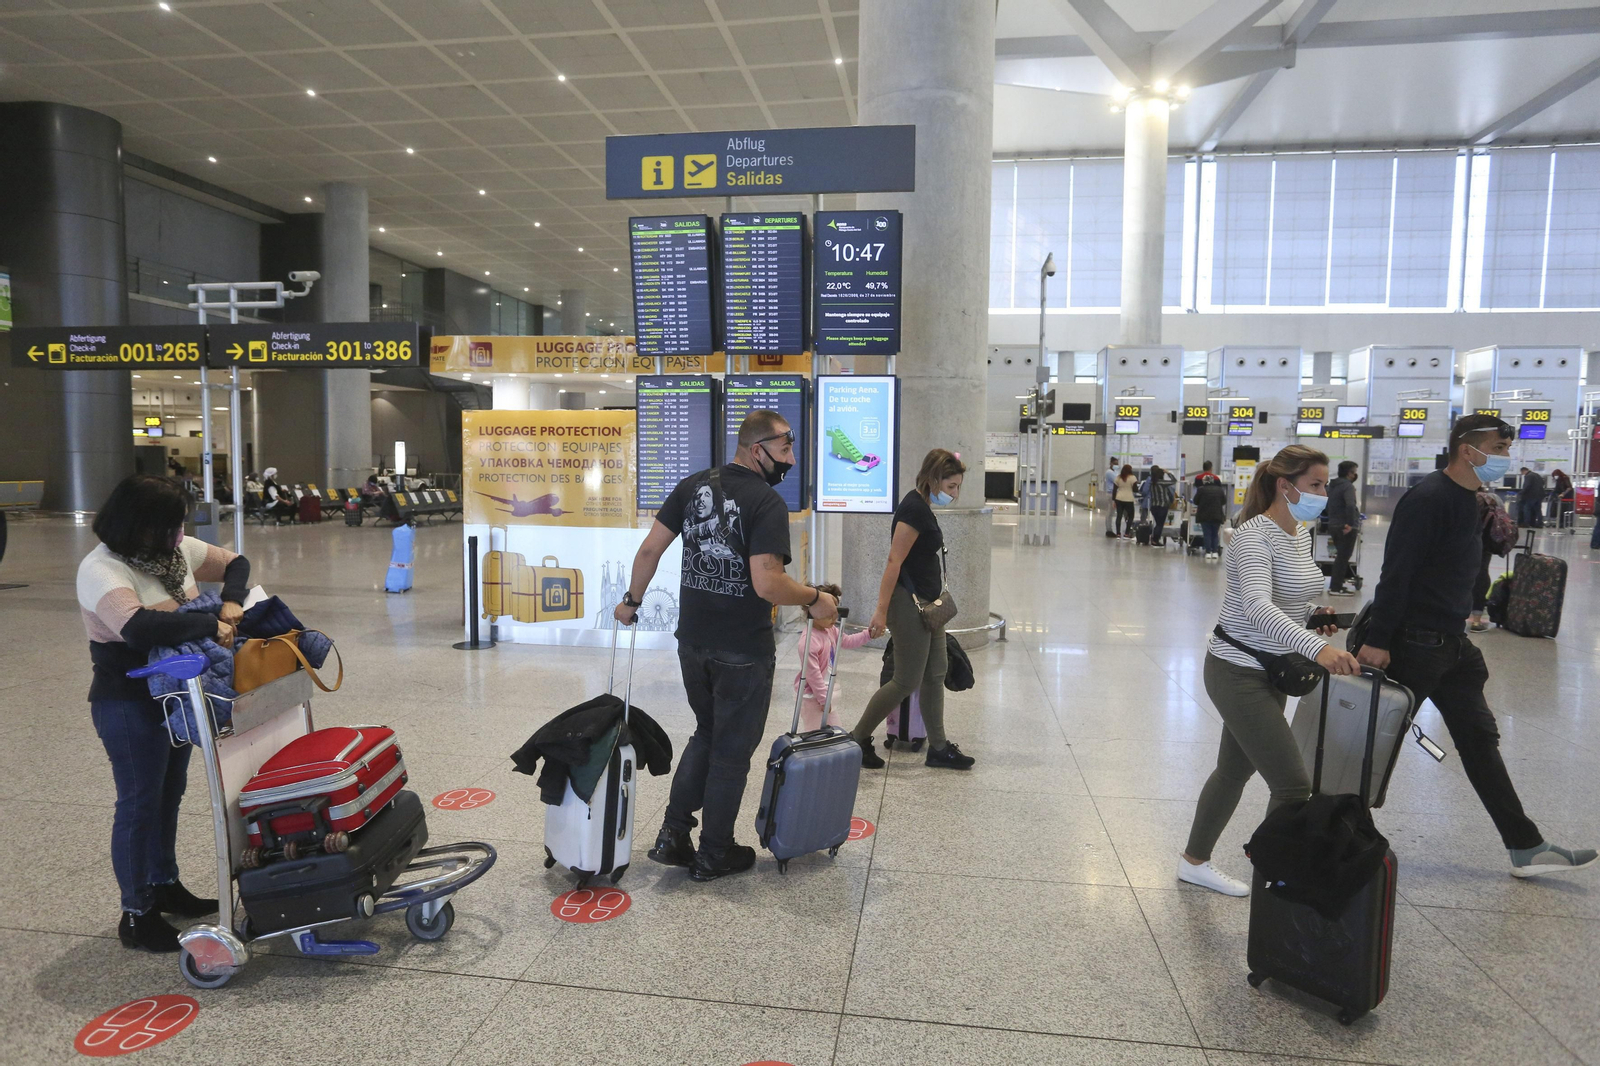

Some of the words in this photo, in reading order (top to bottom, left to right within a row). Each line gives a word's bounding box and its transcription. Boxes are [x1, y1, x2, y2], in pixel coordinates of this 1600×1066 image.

[727, 137, 765, 152] Abflug
[726, 154, 794, 169] Departures
[726, 171, 783, 186] Salidas
[831, 243, 885, 262] 10:47
[69, 334, 107, 344] Abfertigung
[271, 331, 311, 342] Abfertigung
[69, 344, 97, 352] Check-in
[155, 343, 163, 351] to
[271, 341, 300, 350] Check-in
[364, 341, 372, 350] to
[271, 351, 323, 362] Facturación
[325, 340, 363, 361] 301
[365, 353, 371, 361] a
[372, 340, 412, 361] 386
[536, 342, 603, 353] LUGGAGE
[607, 342, 636, 353] PRO
[70, 353, 119, 363] Facturación
[119, 342, 156, 362] 001
[162, 342, 200, 362] 265
[632, 355, 701, 371] EQUPAJES
[828, 386, 858, 395] Parking
[858, 386, 880, 394] Aena.
[828, 395, 839, 403] De
[850, 395, 871, 403] coche
[828, 405, 836, 413] al
[836, 405, 859, 413] avión.
[1118, 406, 1140, 417] 302
[1186, 407, 1208, 418] 303
[1232, 407, 1254, 418] 304
[1300, 408, 1323, 419] 305
[1402, 409, 1426, 420] 306
[1524, 410, 1549, 421] 308
[478, 426, 537, 436] LUGGAGE
[540, 426, 622, 437] PROTECTION
[562, 441, 623, 455] EQUIPAJES
[479, 457, 544, 468] УПАКОВКА
[547, 458, 624, 470] ЧЕМОДАНОВ
[478, 473, 546, 483] PROTECTION
[550, 474, 571, 483] DES
[575, 474, 623, 484] BAGES
[681, 546, 748, 582] BOB
